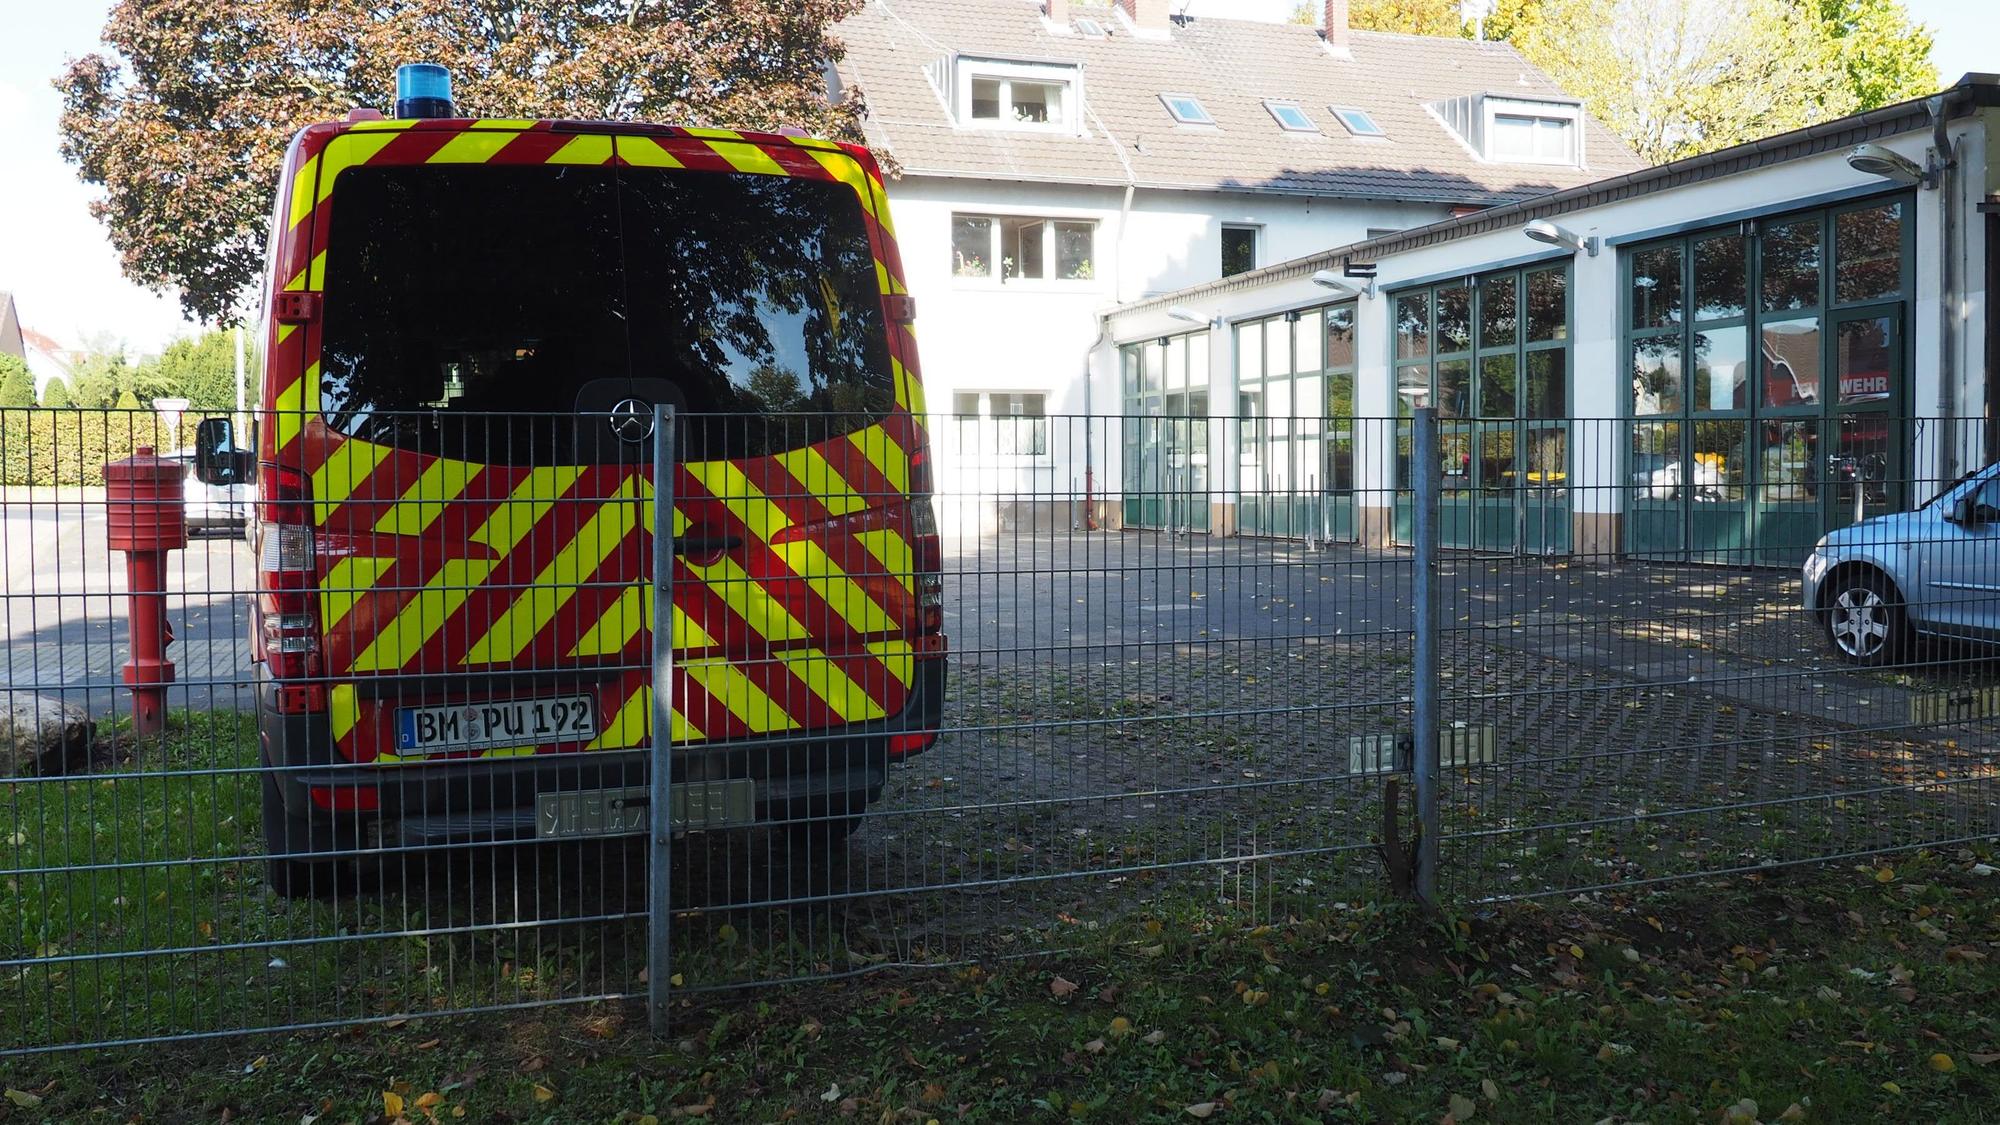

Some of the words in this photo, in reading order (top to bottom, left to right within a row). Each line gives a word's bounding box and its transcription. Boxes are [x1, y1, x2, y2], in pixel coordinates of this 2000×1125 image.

[416, 710, 460, 743] BM
[481, 705, 524, 738] PU
[531, 701, 590, 734] 192
